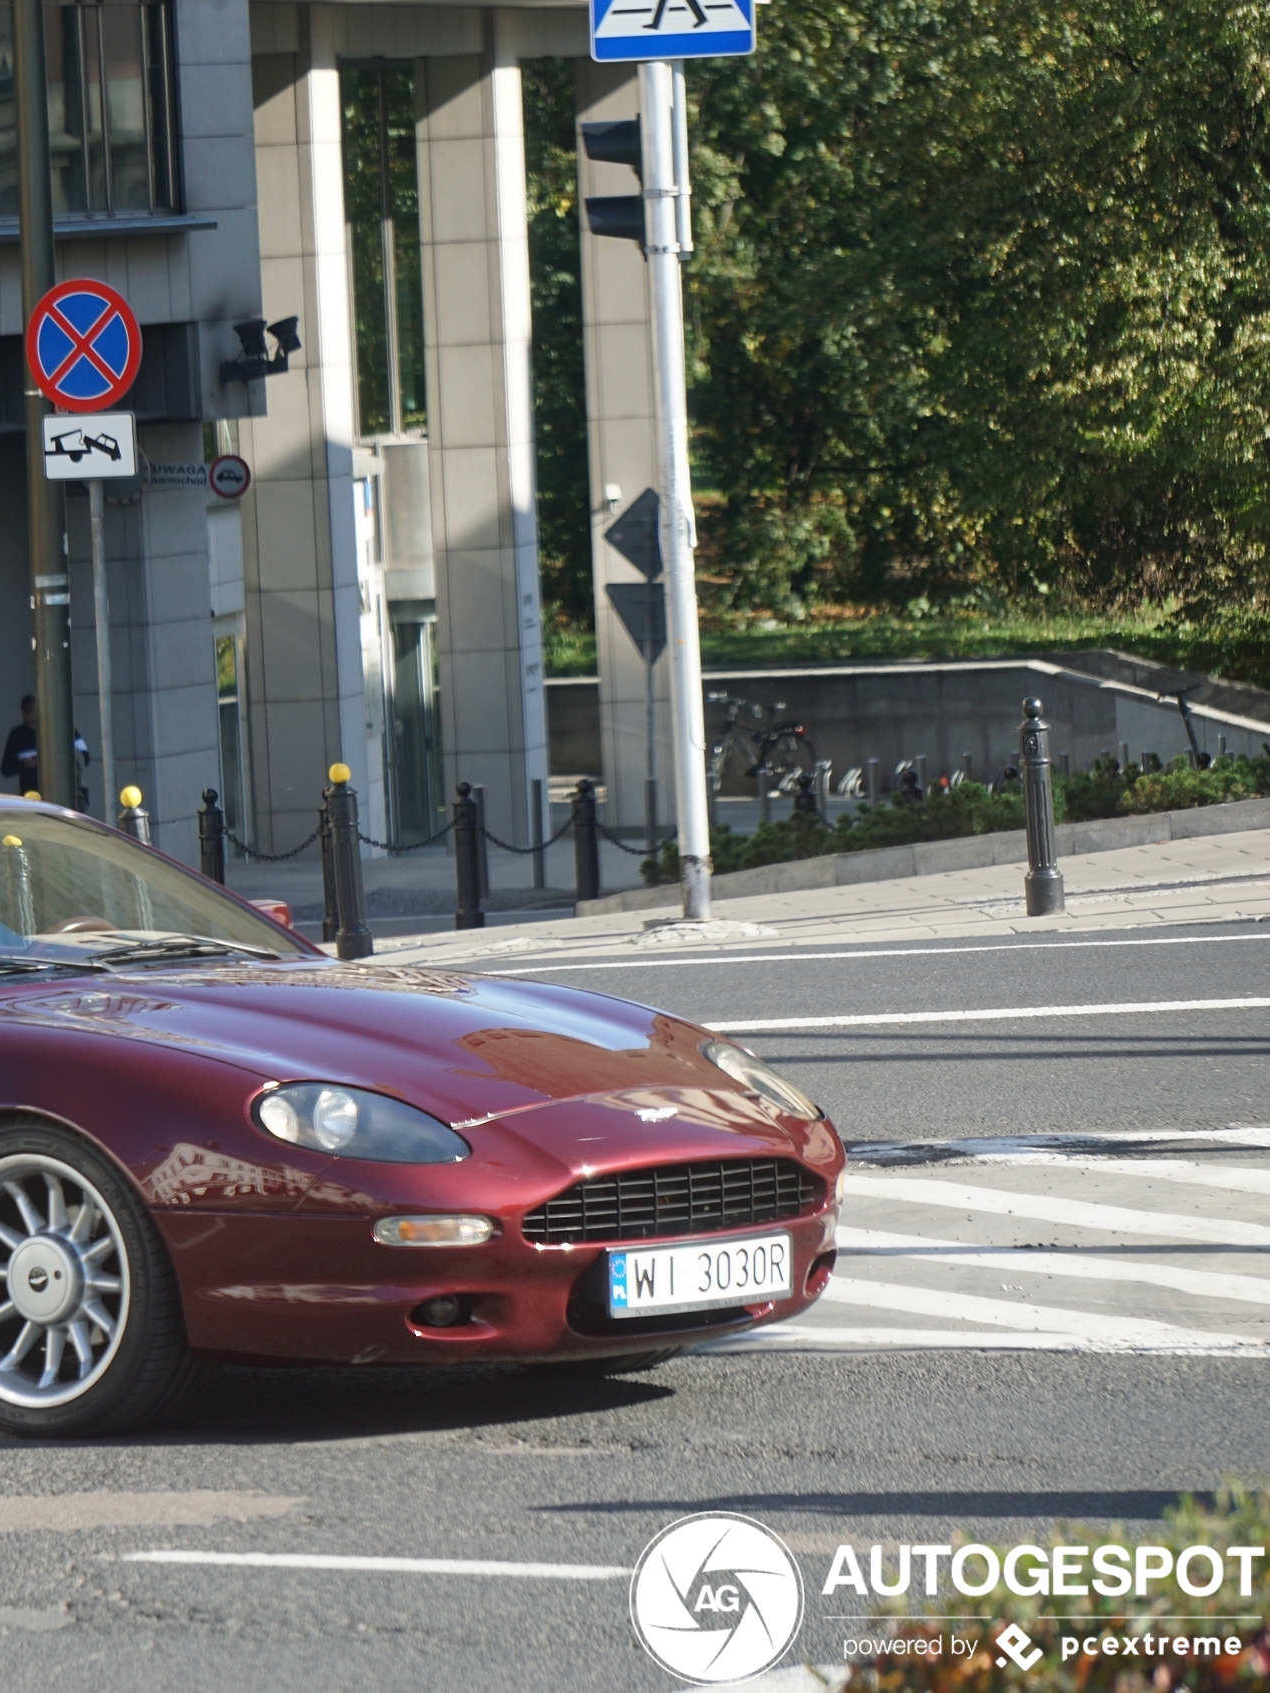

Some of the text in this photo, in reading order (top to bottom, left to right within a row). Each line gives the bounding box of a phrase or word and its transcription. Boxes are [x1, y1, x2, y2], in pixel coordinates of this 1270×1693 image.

[152, 464, 206, 475] UWAGA
[634, 1243, 785, 1299] WI 3030R
[612, 1285, 627, 1300] PL
